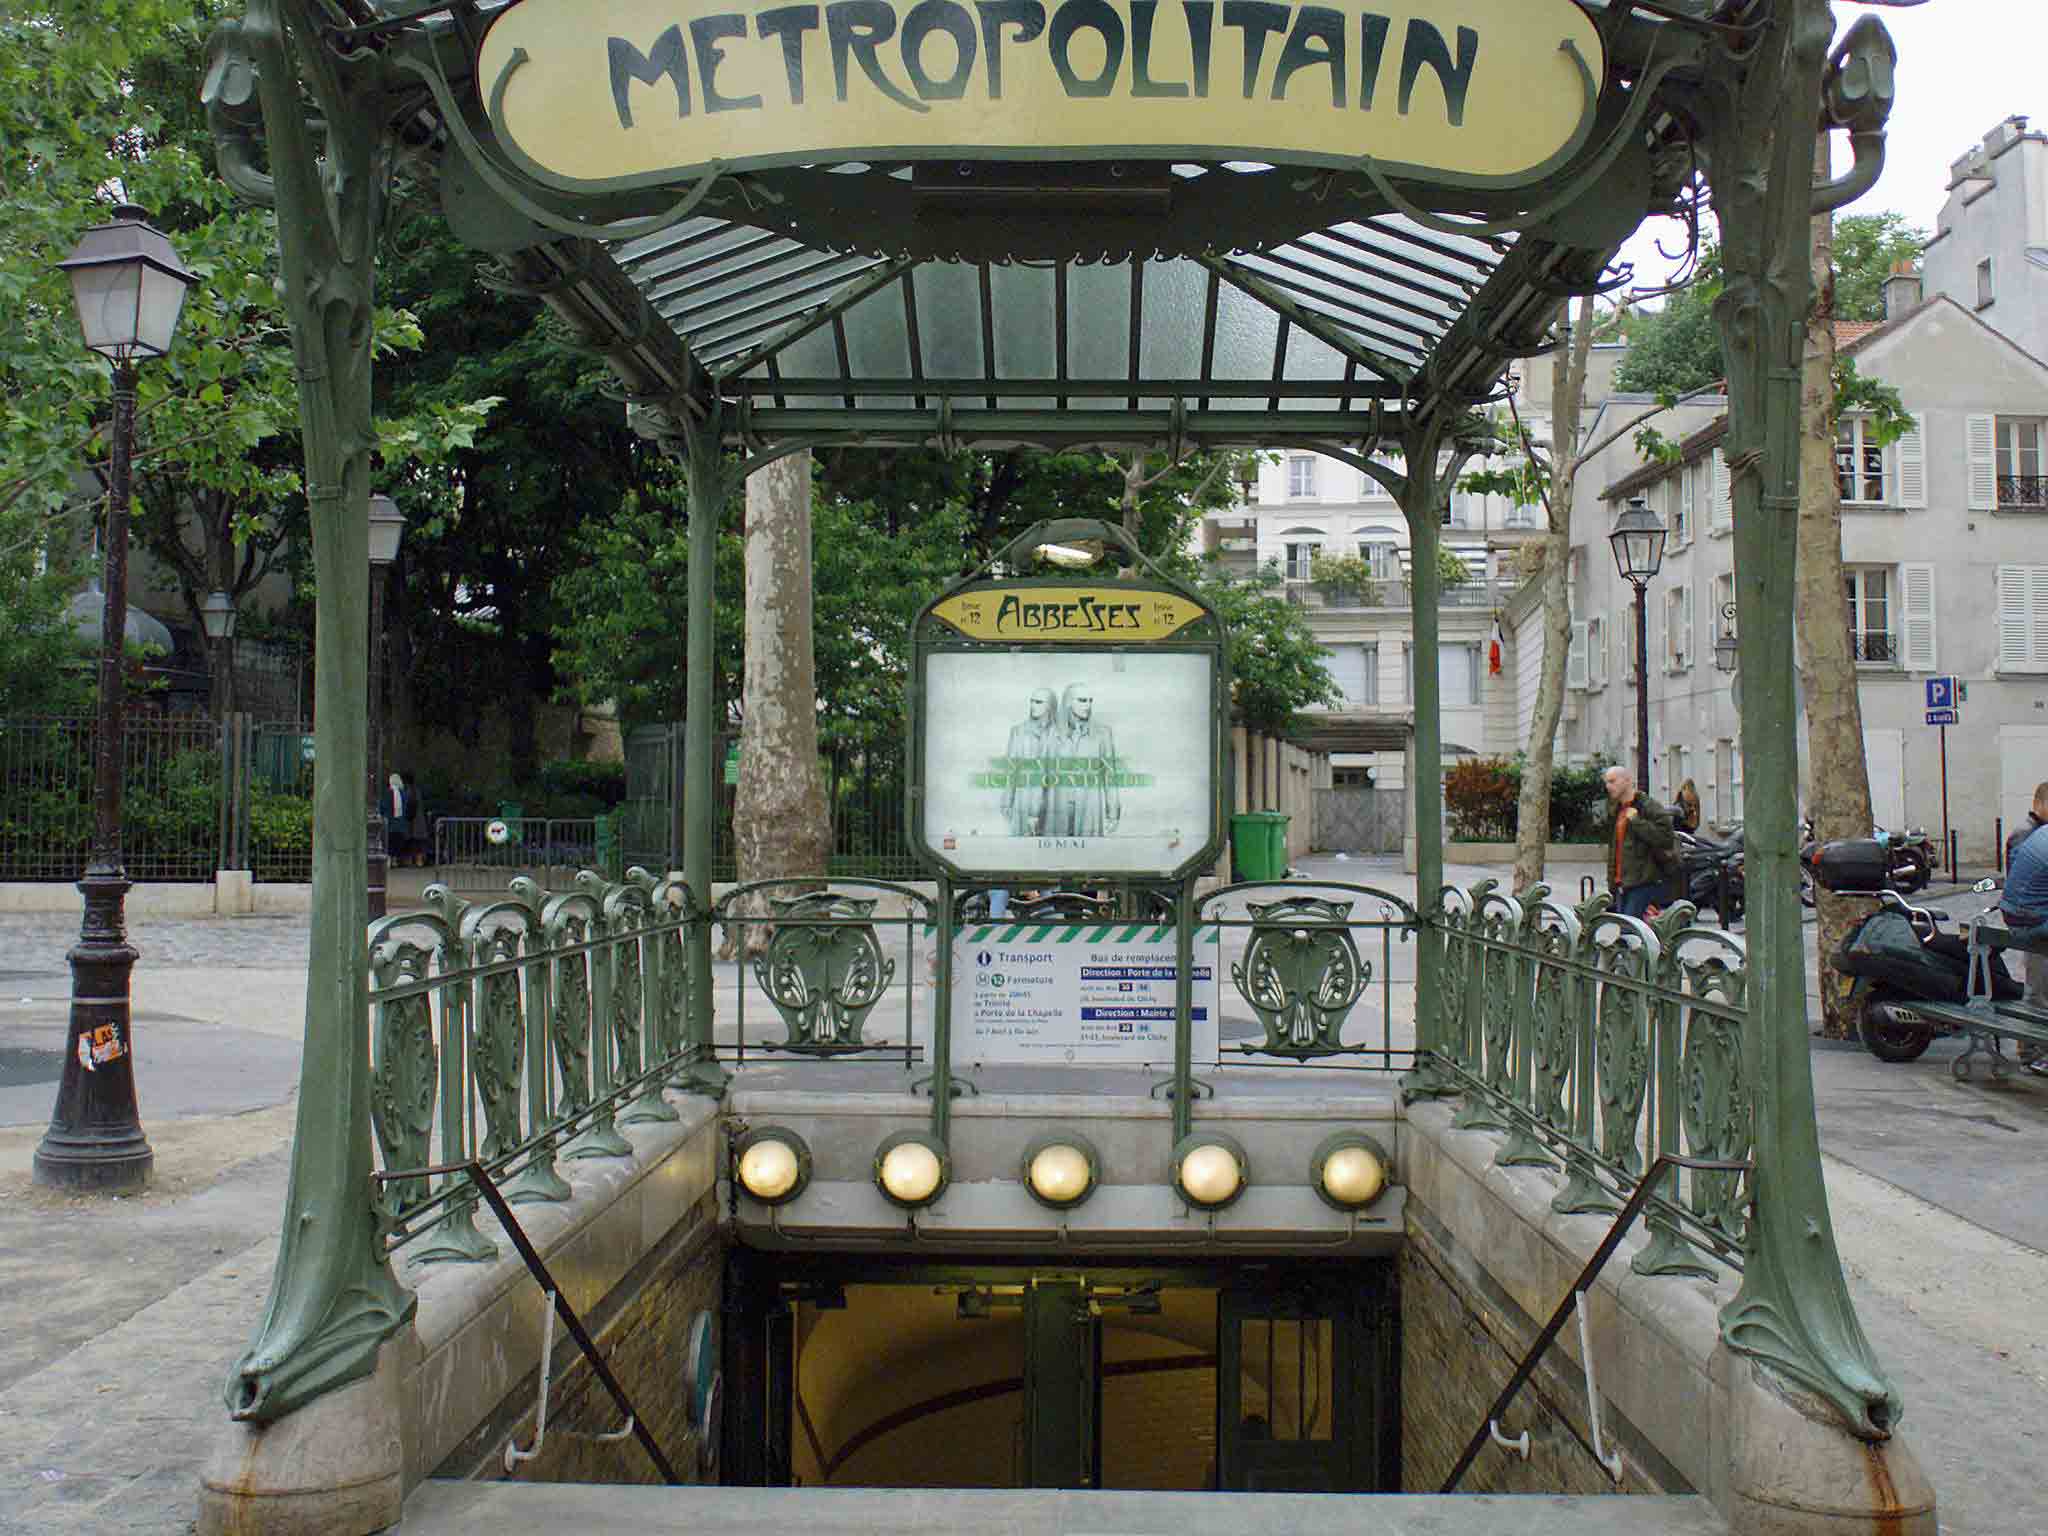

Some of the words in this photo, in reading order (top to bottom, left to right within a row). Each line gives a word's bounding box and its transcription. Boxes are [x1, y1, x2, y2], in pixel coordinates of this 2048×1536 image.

[608, 0, 1480, 128] METROPOLITAIN
[970, 612, 981, 625] 12
[1164, 613, 1175, 625] 12
[1932, 683, 1945, 703] P
[999, 952, 1053, 965] Transport
[1082, 967, 1121, 977] Direction
[1128, 967, 1151, 977] Porte
[1152, 967, 1161, 977] de
[1095, 1008, 1135, 1017] Direction
